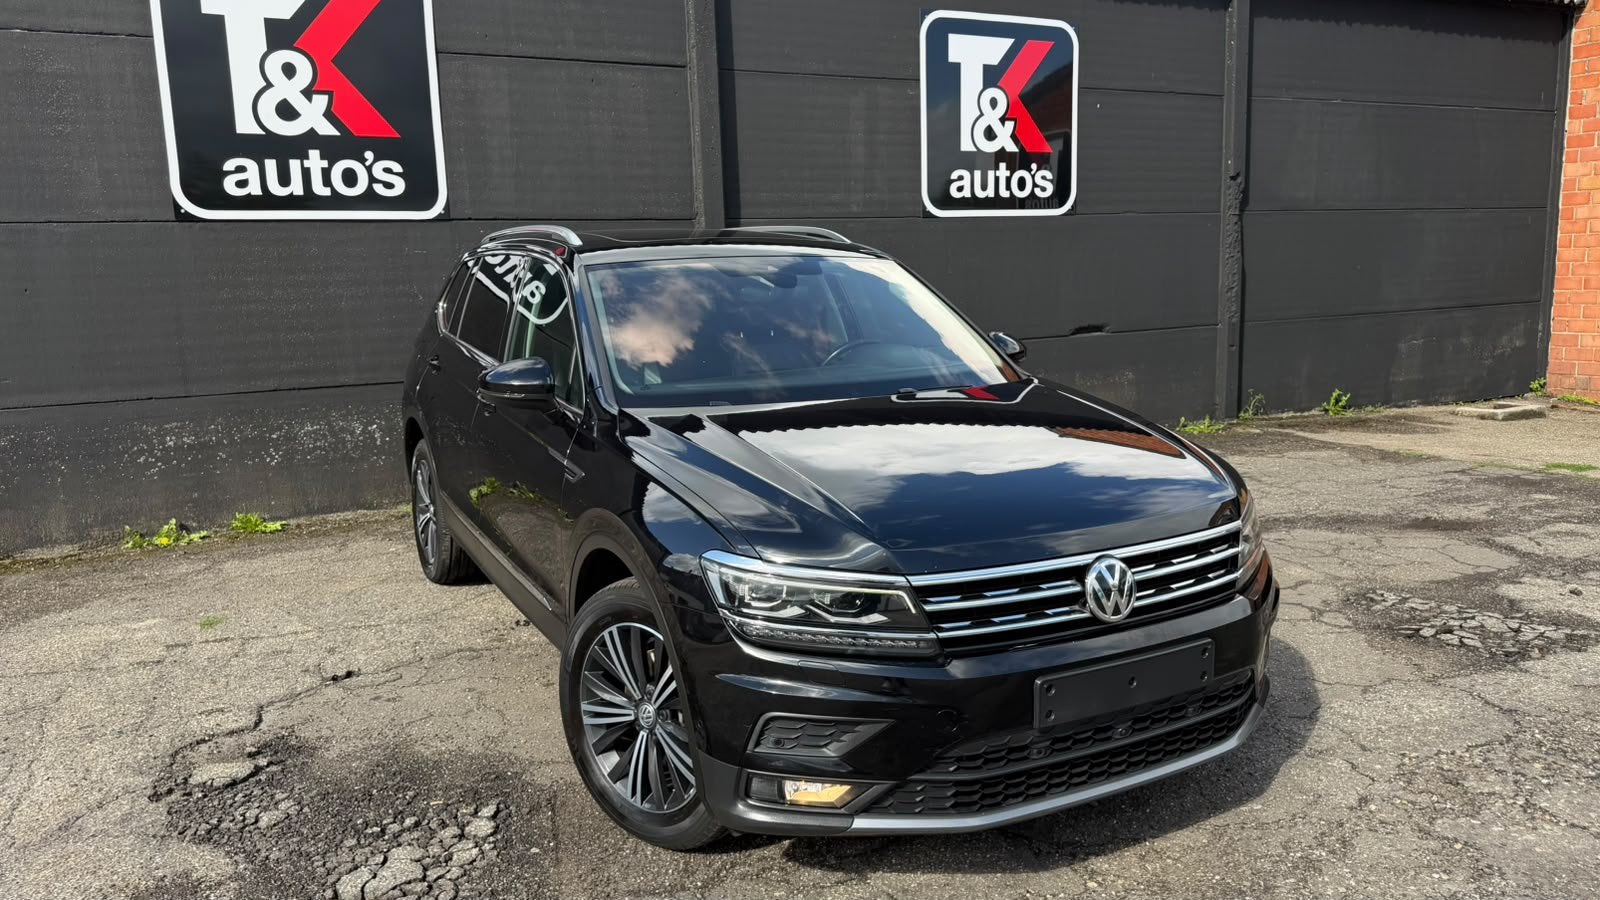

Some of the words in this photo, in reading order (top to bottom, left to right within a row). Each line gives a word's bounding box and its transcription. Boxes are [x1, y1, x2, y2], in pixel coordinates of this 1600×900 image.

[199, 0, 401, 137] T&K
[948, 33, 1055, 153] T&K
[222, 149, 406, 197] auto's
[950, 162, 1054, 198] auto's
[1086, 557, 1137, 622] VW
